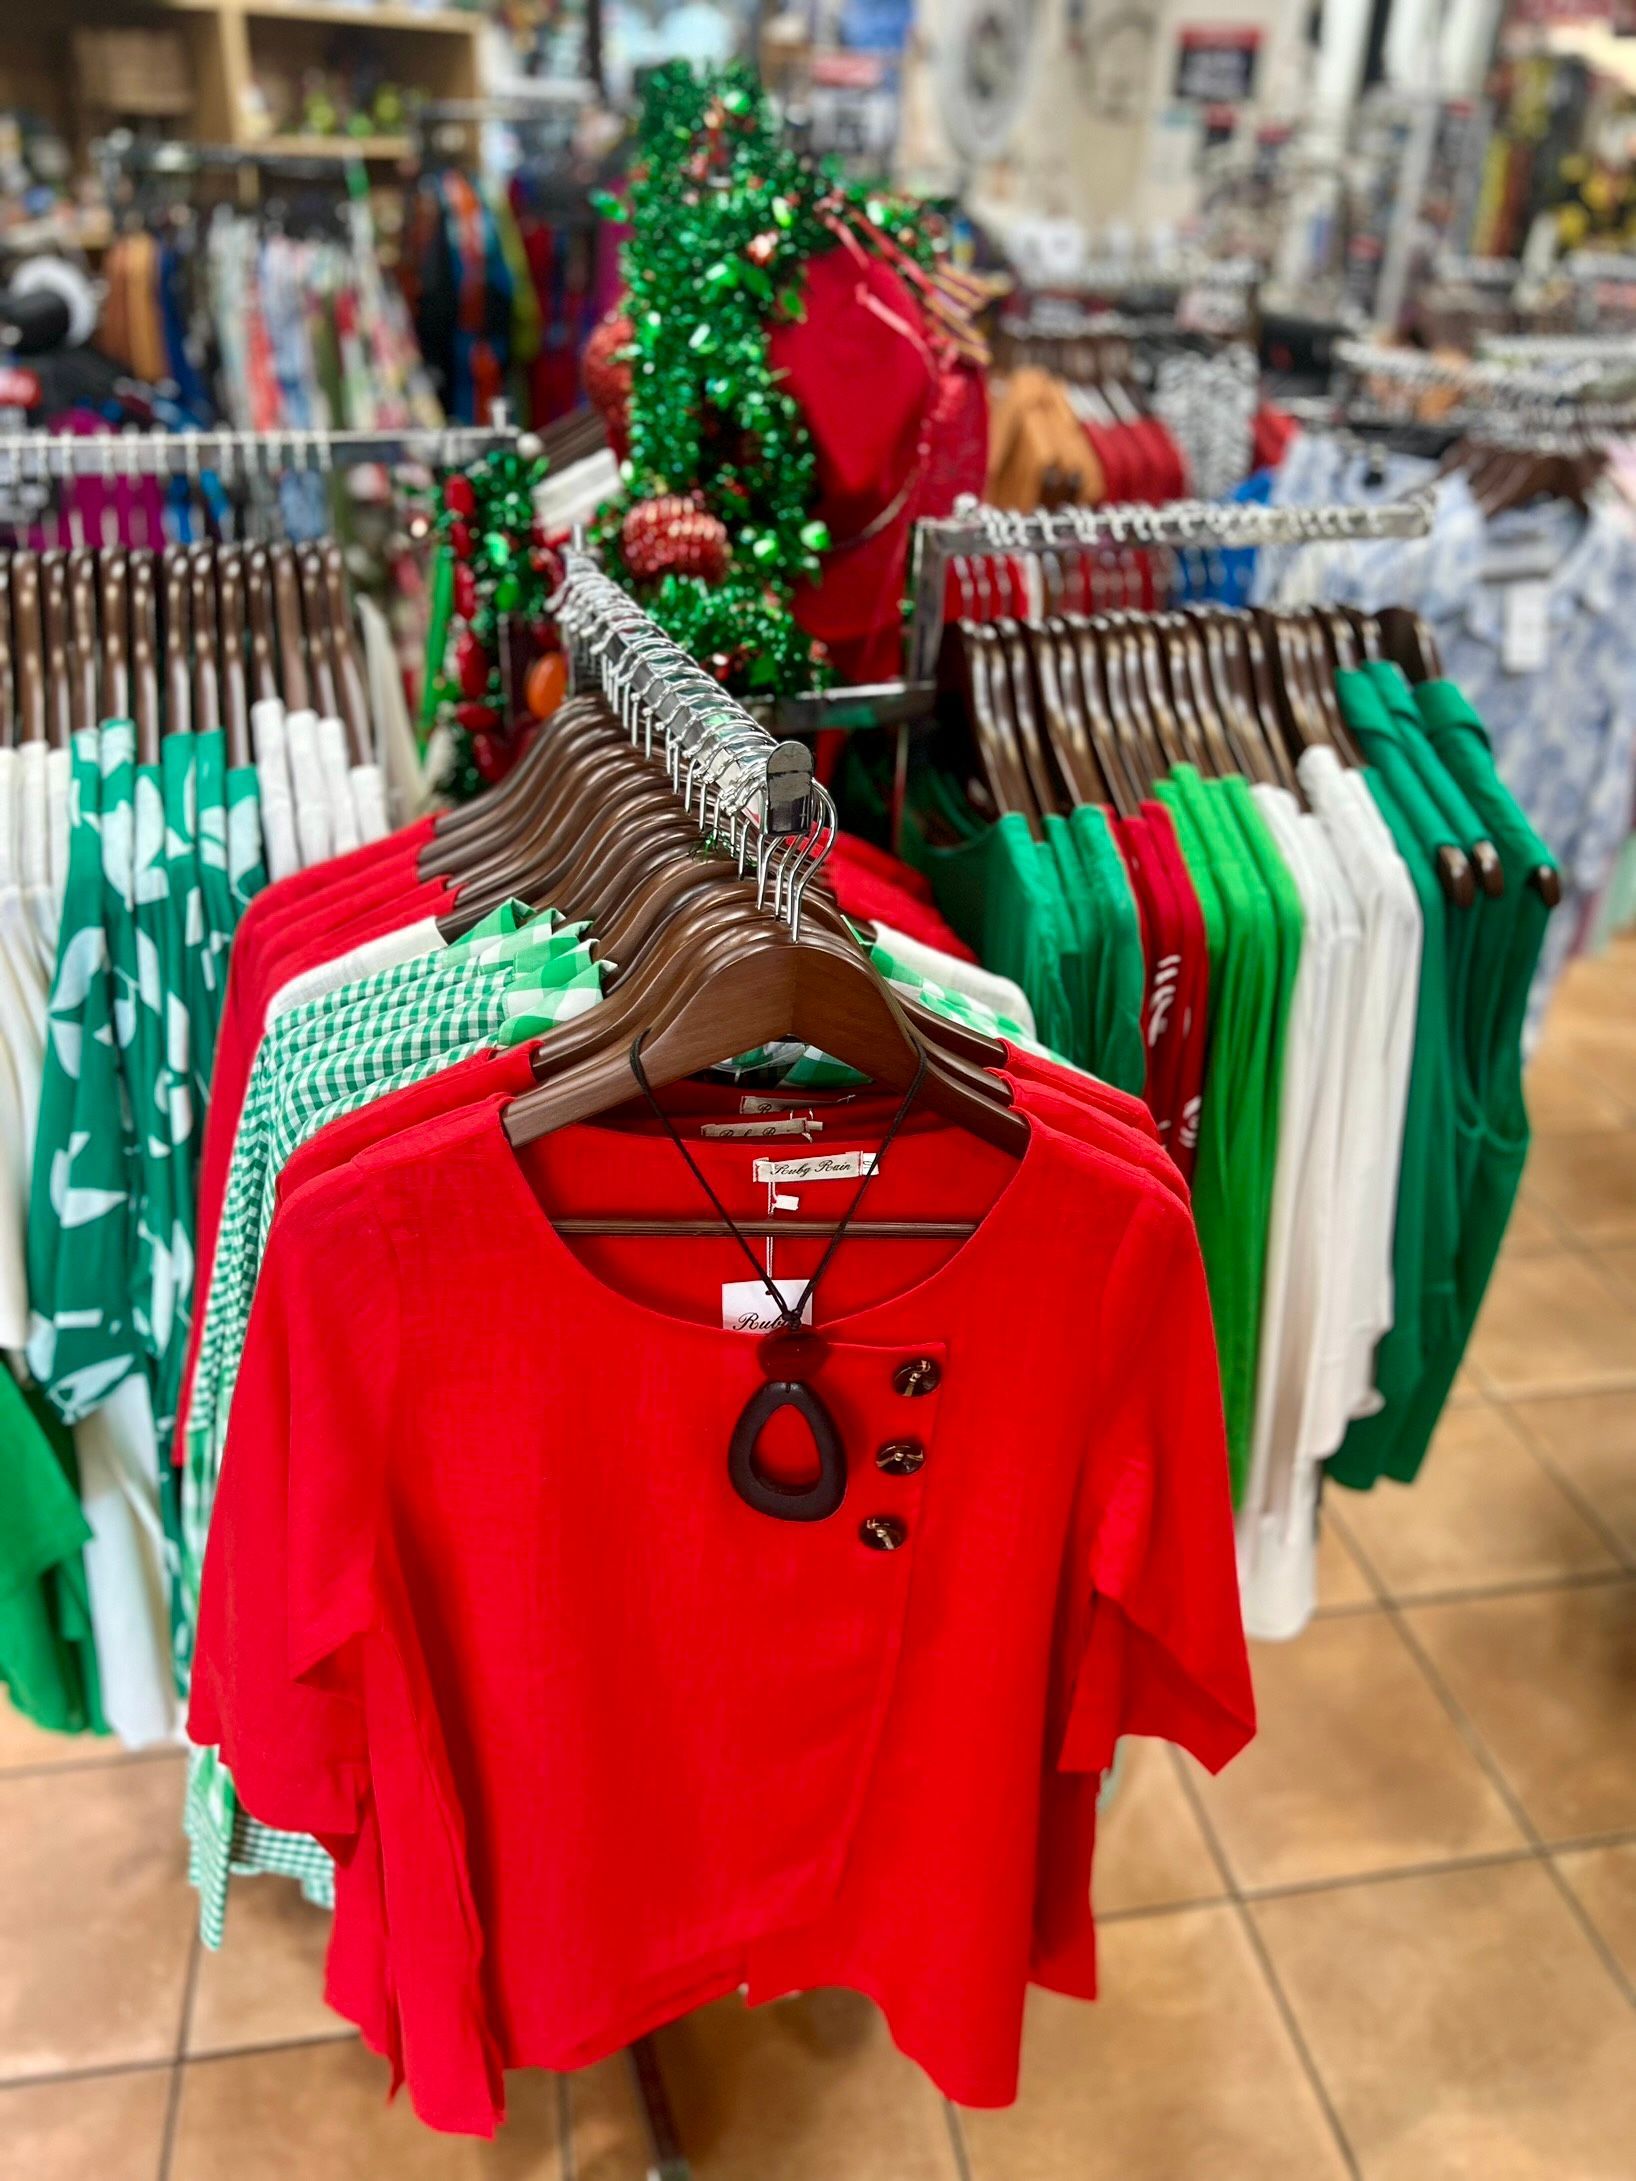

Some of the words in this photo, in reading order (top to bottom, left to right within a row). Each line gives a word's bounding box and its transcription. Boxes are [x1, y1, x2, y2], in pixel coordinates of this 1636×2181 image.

[770, 1164, 811, 1177] Ruby
[815, 1160, 851, 1172] Rain
[733, 1312, 791, 1331] Rub
